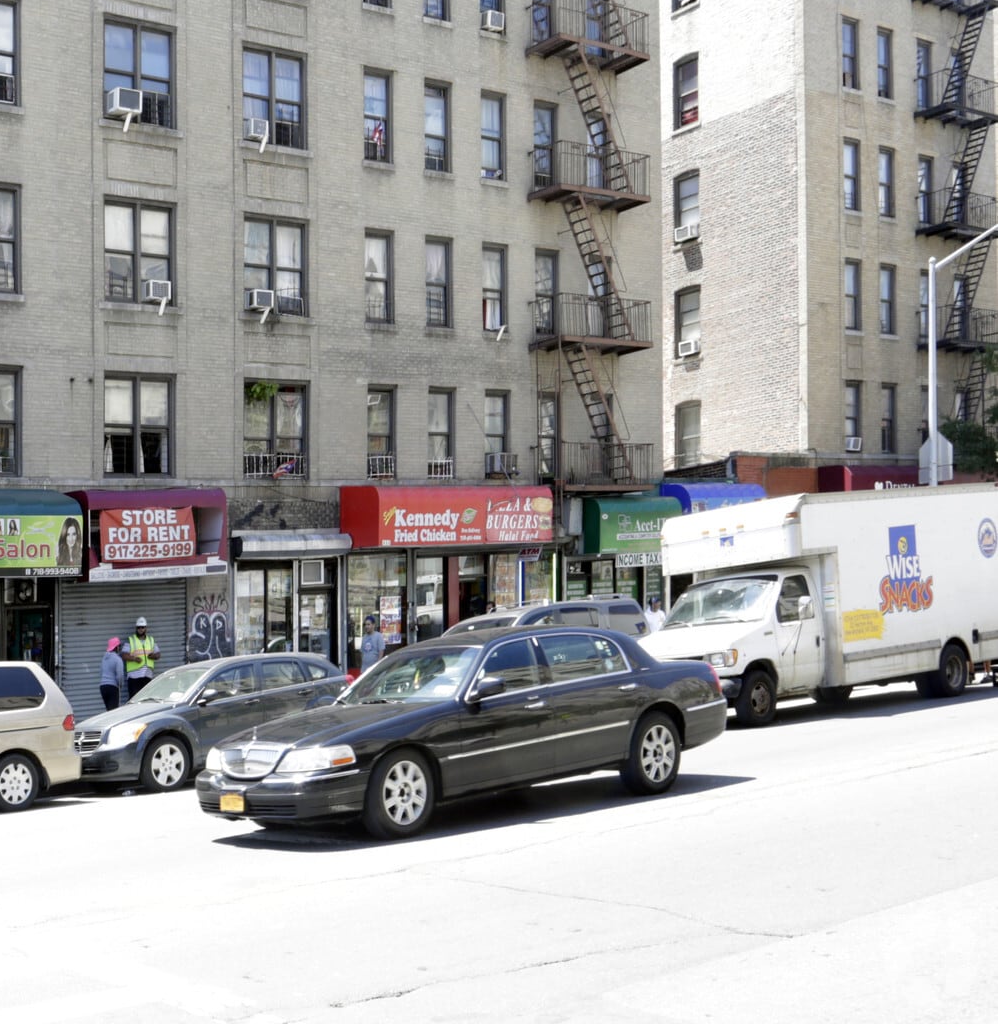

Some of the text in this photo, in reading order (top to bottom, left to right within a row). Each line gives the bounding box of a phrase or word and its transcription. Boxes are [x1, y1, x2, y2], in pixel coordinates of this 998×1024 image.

[122, 509, 178, 526] STORE
[394, 508, 460, 530] Kennedy
[486, 514, 539, 529] BURGERS
[108, 525, 190, 543] FOR RENT
[394, 529, 419, 543] Fried
[420, 528, 457, 542] Chicken
[498, 530, 519, 541] Halal
[107, 542, 192, 558] 917-225-9199
[521, 547, 541, 556] ATM
[616, 553, 660, 566] INCOME TAX
[886, 554, 921, 580] WISE
[879, 576, 934, 616] SNACKS
